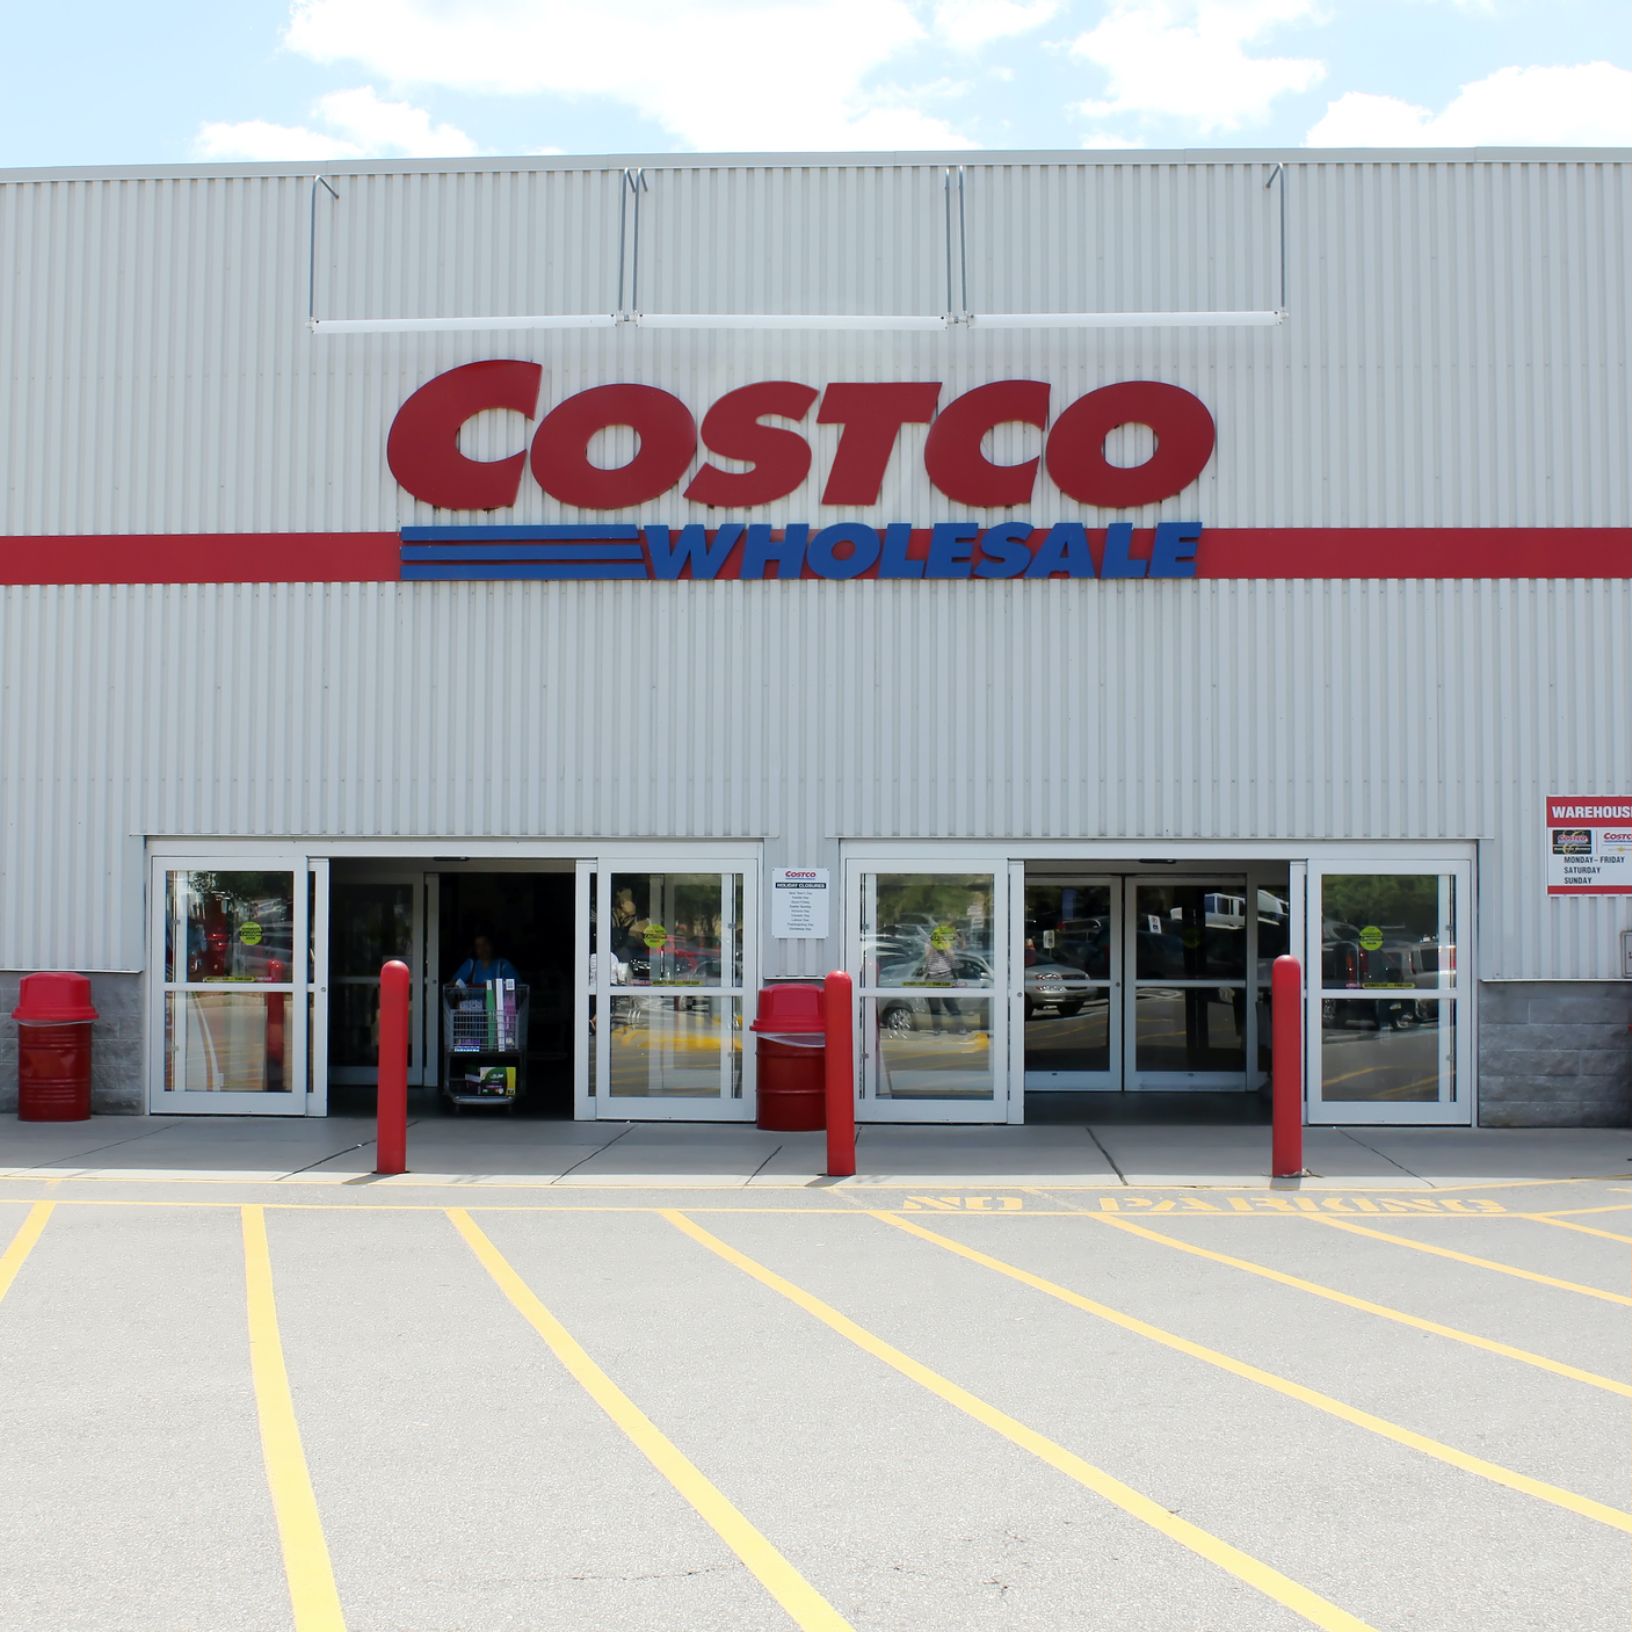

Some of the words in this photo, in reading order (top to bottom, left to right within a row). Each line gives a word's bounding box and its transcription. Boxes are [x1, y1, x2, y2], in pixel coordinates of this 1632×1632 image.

[387, 359, 1215, 510] COSTCO
[643, 521, 1203, 580] WHOLESALE
[1552, 806, 1632, 818] WAREHOUS
[1603, 833, 1632, 841] COSTC
[1563, 856, 1594, 864] MONDAY
[1600, 856, 1625, 864] FRIDAY
[784, 870, 817, 878] COSTCO
[1563, 866, 1601, 874] SATURDAY
[1563, 877, 1592, 885] SUNDAY
[903, 1195, 1023, 1211] NO
[1100, 1197, 1507, 1213] PARKING
